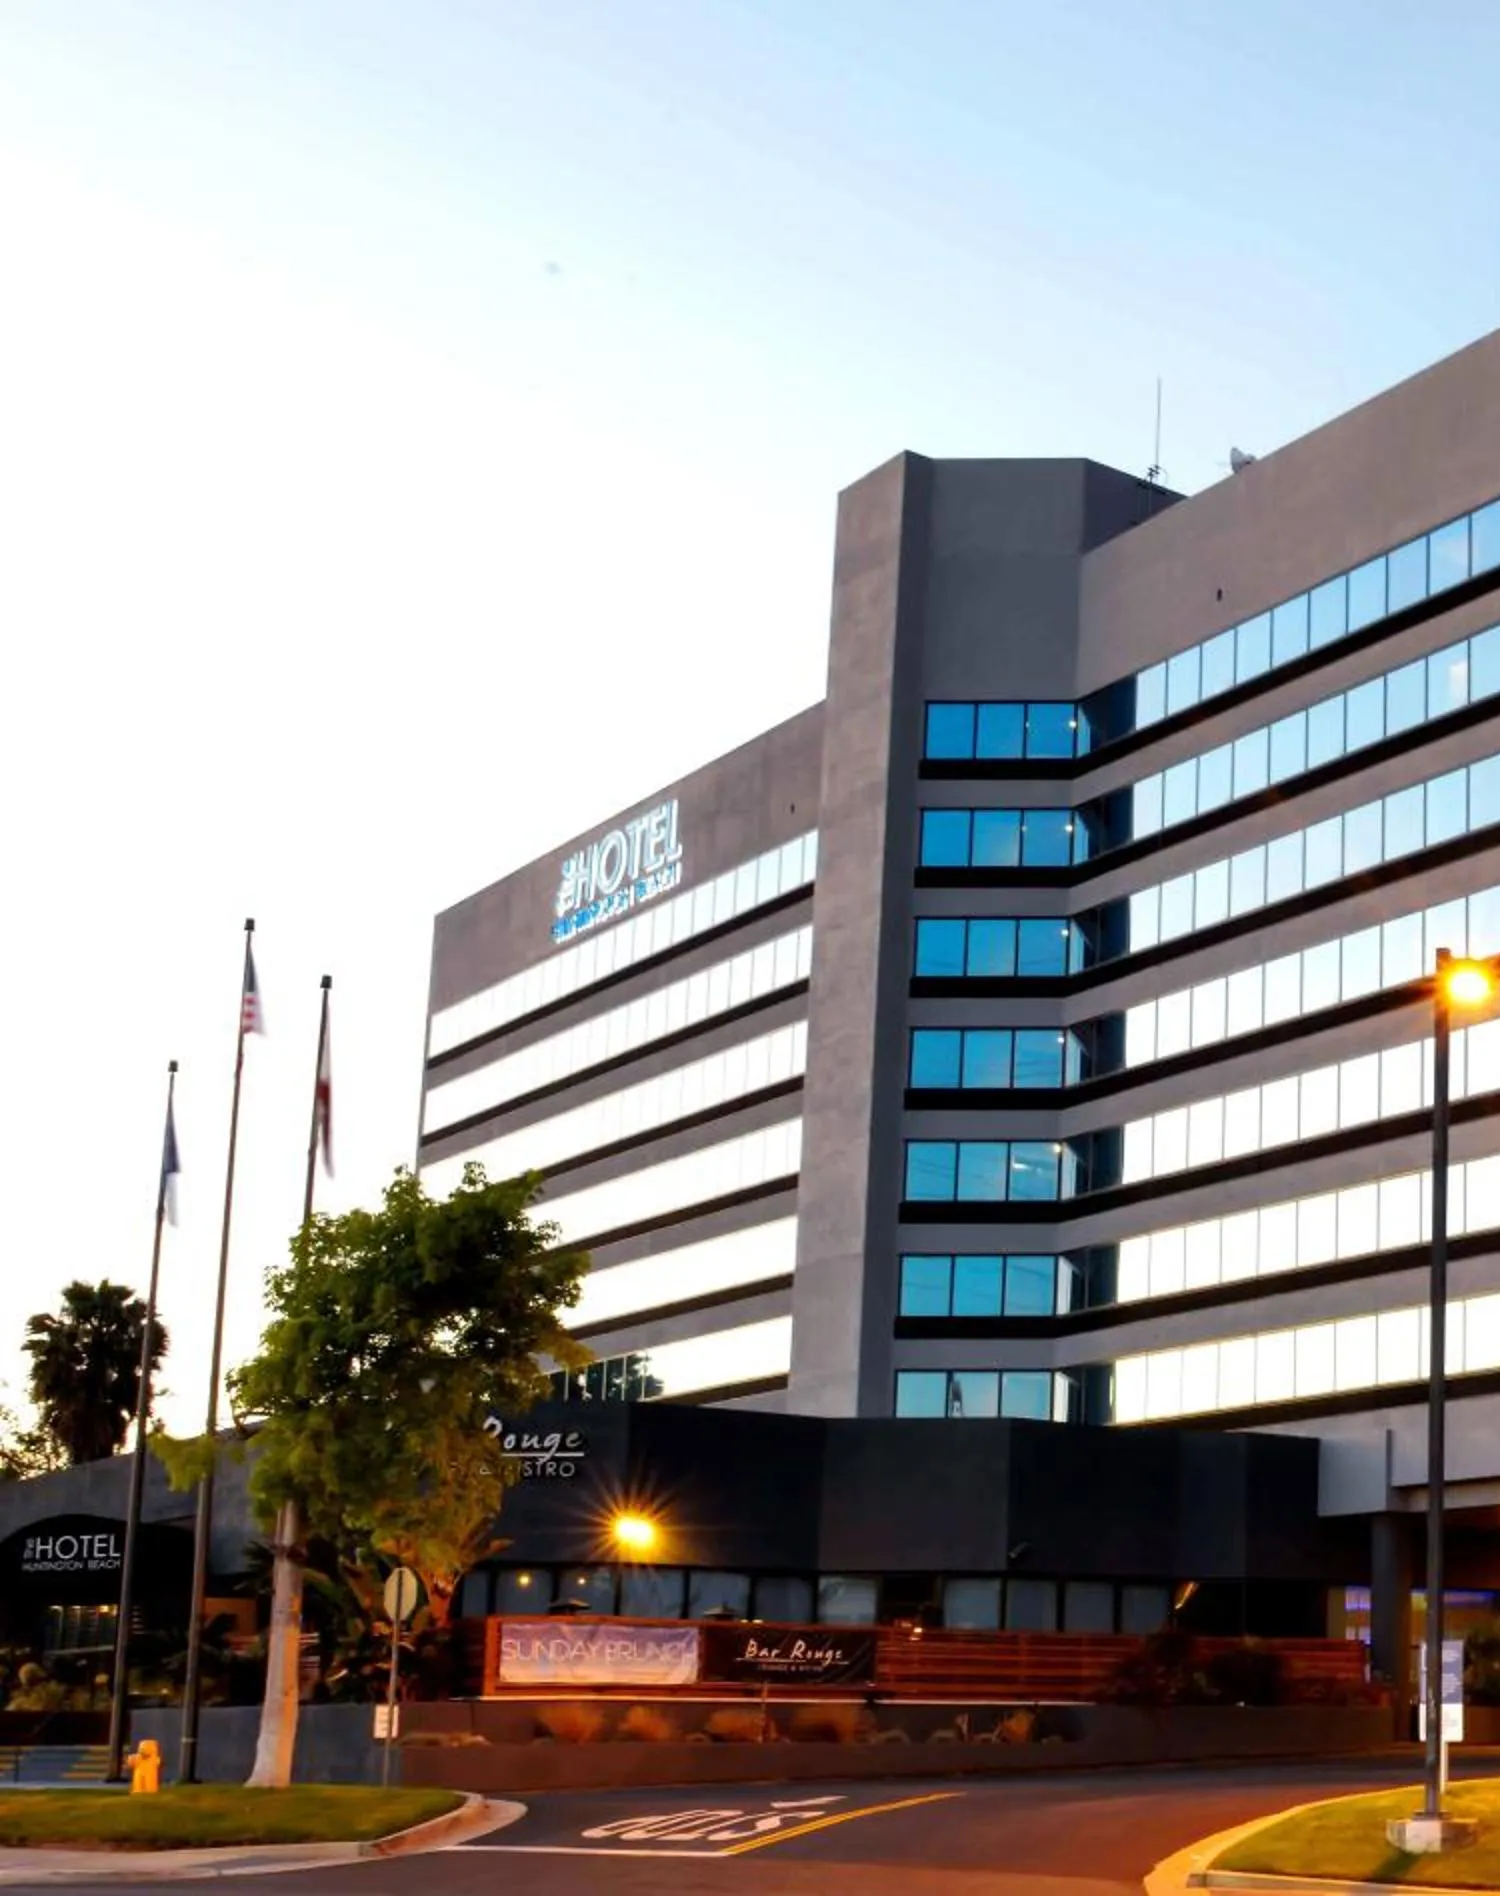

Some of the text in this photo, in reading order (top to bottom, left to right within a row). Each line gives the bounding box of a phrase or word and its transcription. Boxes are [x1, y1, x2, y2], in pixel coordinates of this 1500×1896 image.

[573, 799, 683, 909] HOTEL
[34, 1534, 121, 1560] HOTEL
[87, 1558, 121, 1570] BEACH
[502, 1639, 697, 1666] SUNDAY BRUNCH
[745, 1638, 843, 1668] Bar Rouge
